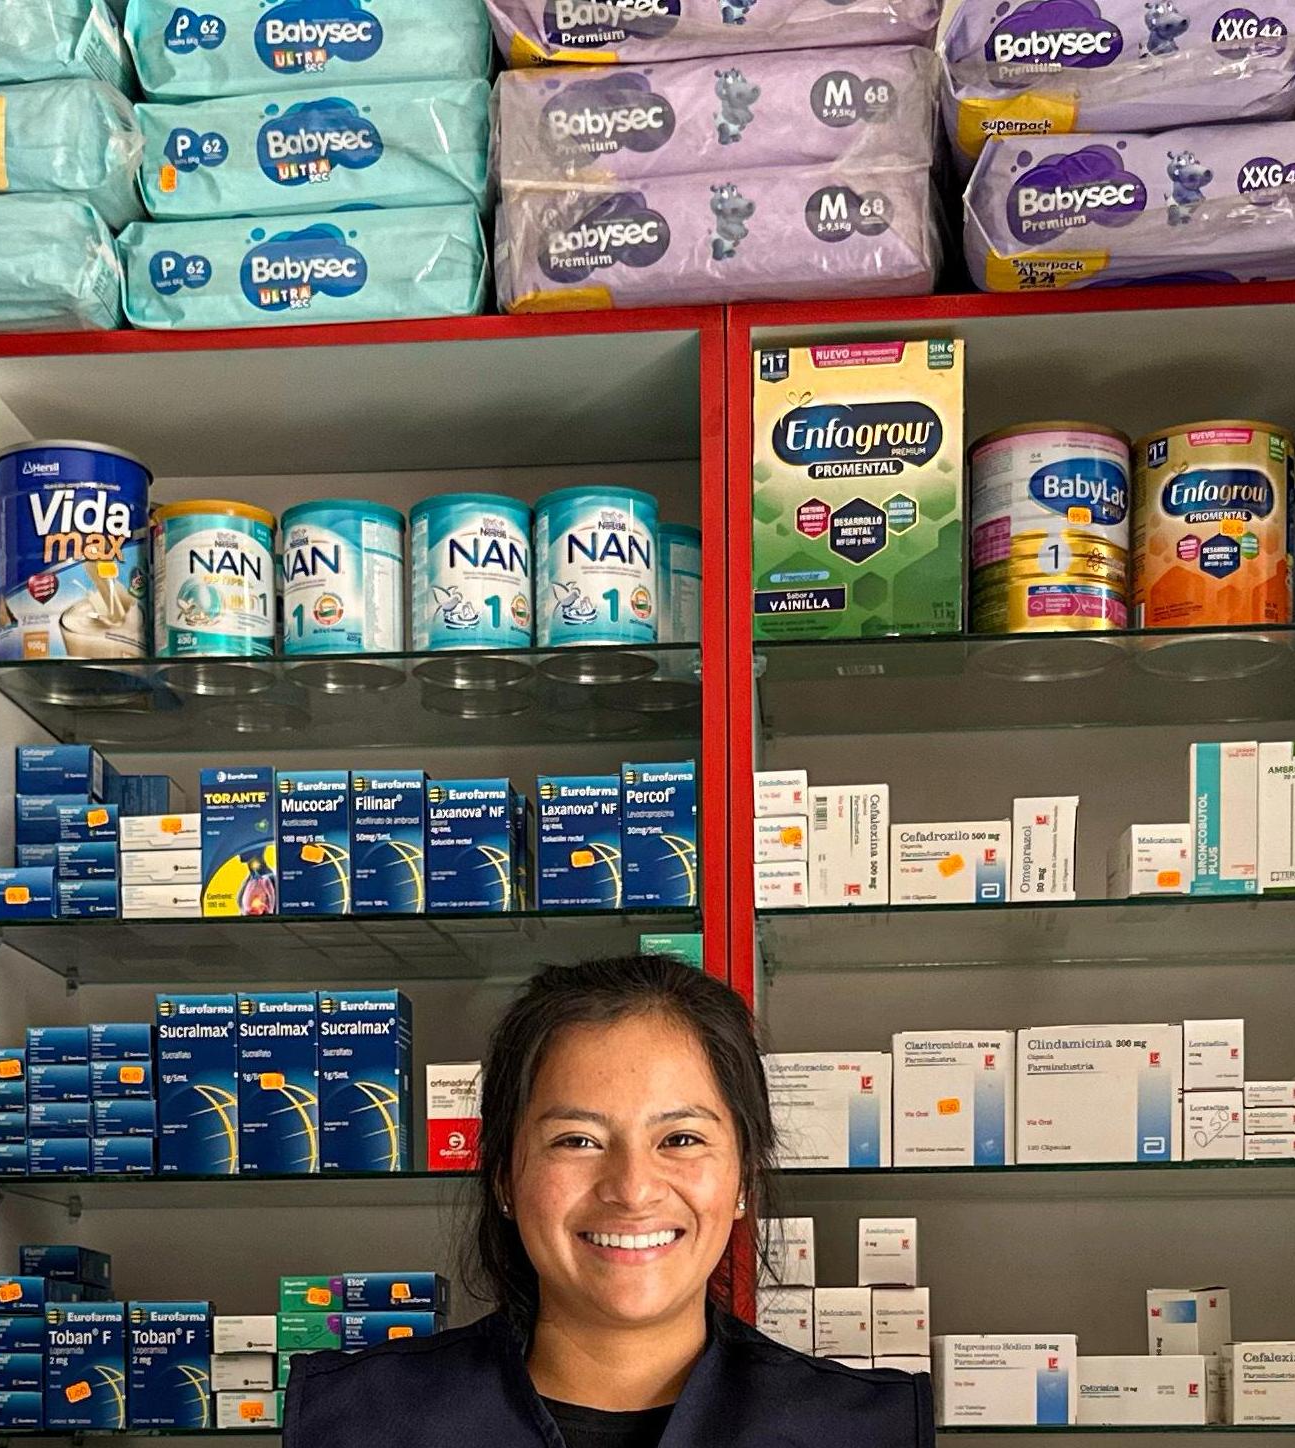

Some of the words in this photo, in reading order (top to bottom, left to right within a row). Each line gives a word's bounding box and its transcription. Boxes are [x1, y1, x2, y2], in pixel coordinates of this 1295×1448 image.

[174, 15, 190, 37] P
[200, 18, 220, 37] 62
[265, 17, 372, 48] Babysec
[1216, 17, 1259, 40] XXG
[1258, 24, 1285, 38] 44
[823, 78, 853, 107] M
[864, 85, 890, 105] 68
[980, 118, 1054, 135] superpack
[266, 127, 374, 160] Babysec
[1020, 212, 1087, 233] Premium
[786, 416, 930, 455] Enfagrow
[814, 461, 899, 478] PROMENTAL
[1043, 474, 1127, 510] BabyLac
[1048, 544, 1060, 569] 1
[189, 550, 262, 582] NAN
[769, 597, 831, 611] VAINILLA
[204, 791, 266, 805] TORANTE
[281, 797, 338, 813] Mucocar
[626, 787, 670, 805] Percof
[430, 805, 482, 820] Laxanova
[489, 805, 505, 819] NF
[899, 829, 970, 843] Cefadroxilo
[1197, 793, 1208, 876] BRONCOBUTOL
[1019, 825, 1032, 894] Omeprazol
[339, 1000, 396, 1012] Eurofarma
[159, 1023, 230, 1040] Sucralmax
[1026, 1037, 1113, 1050] Clindamicina
[1027, 1061, 1095, 1072] Farmindustria
[48, 1330, 92, 1346] Toban
[102, 1330, 112, 1345] F
